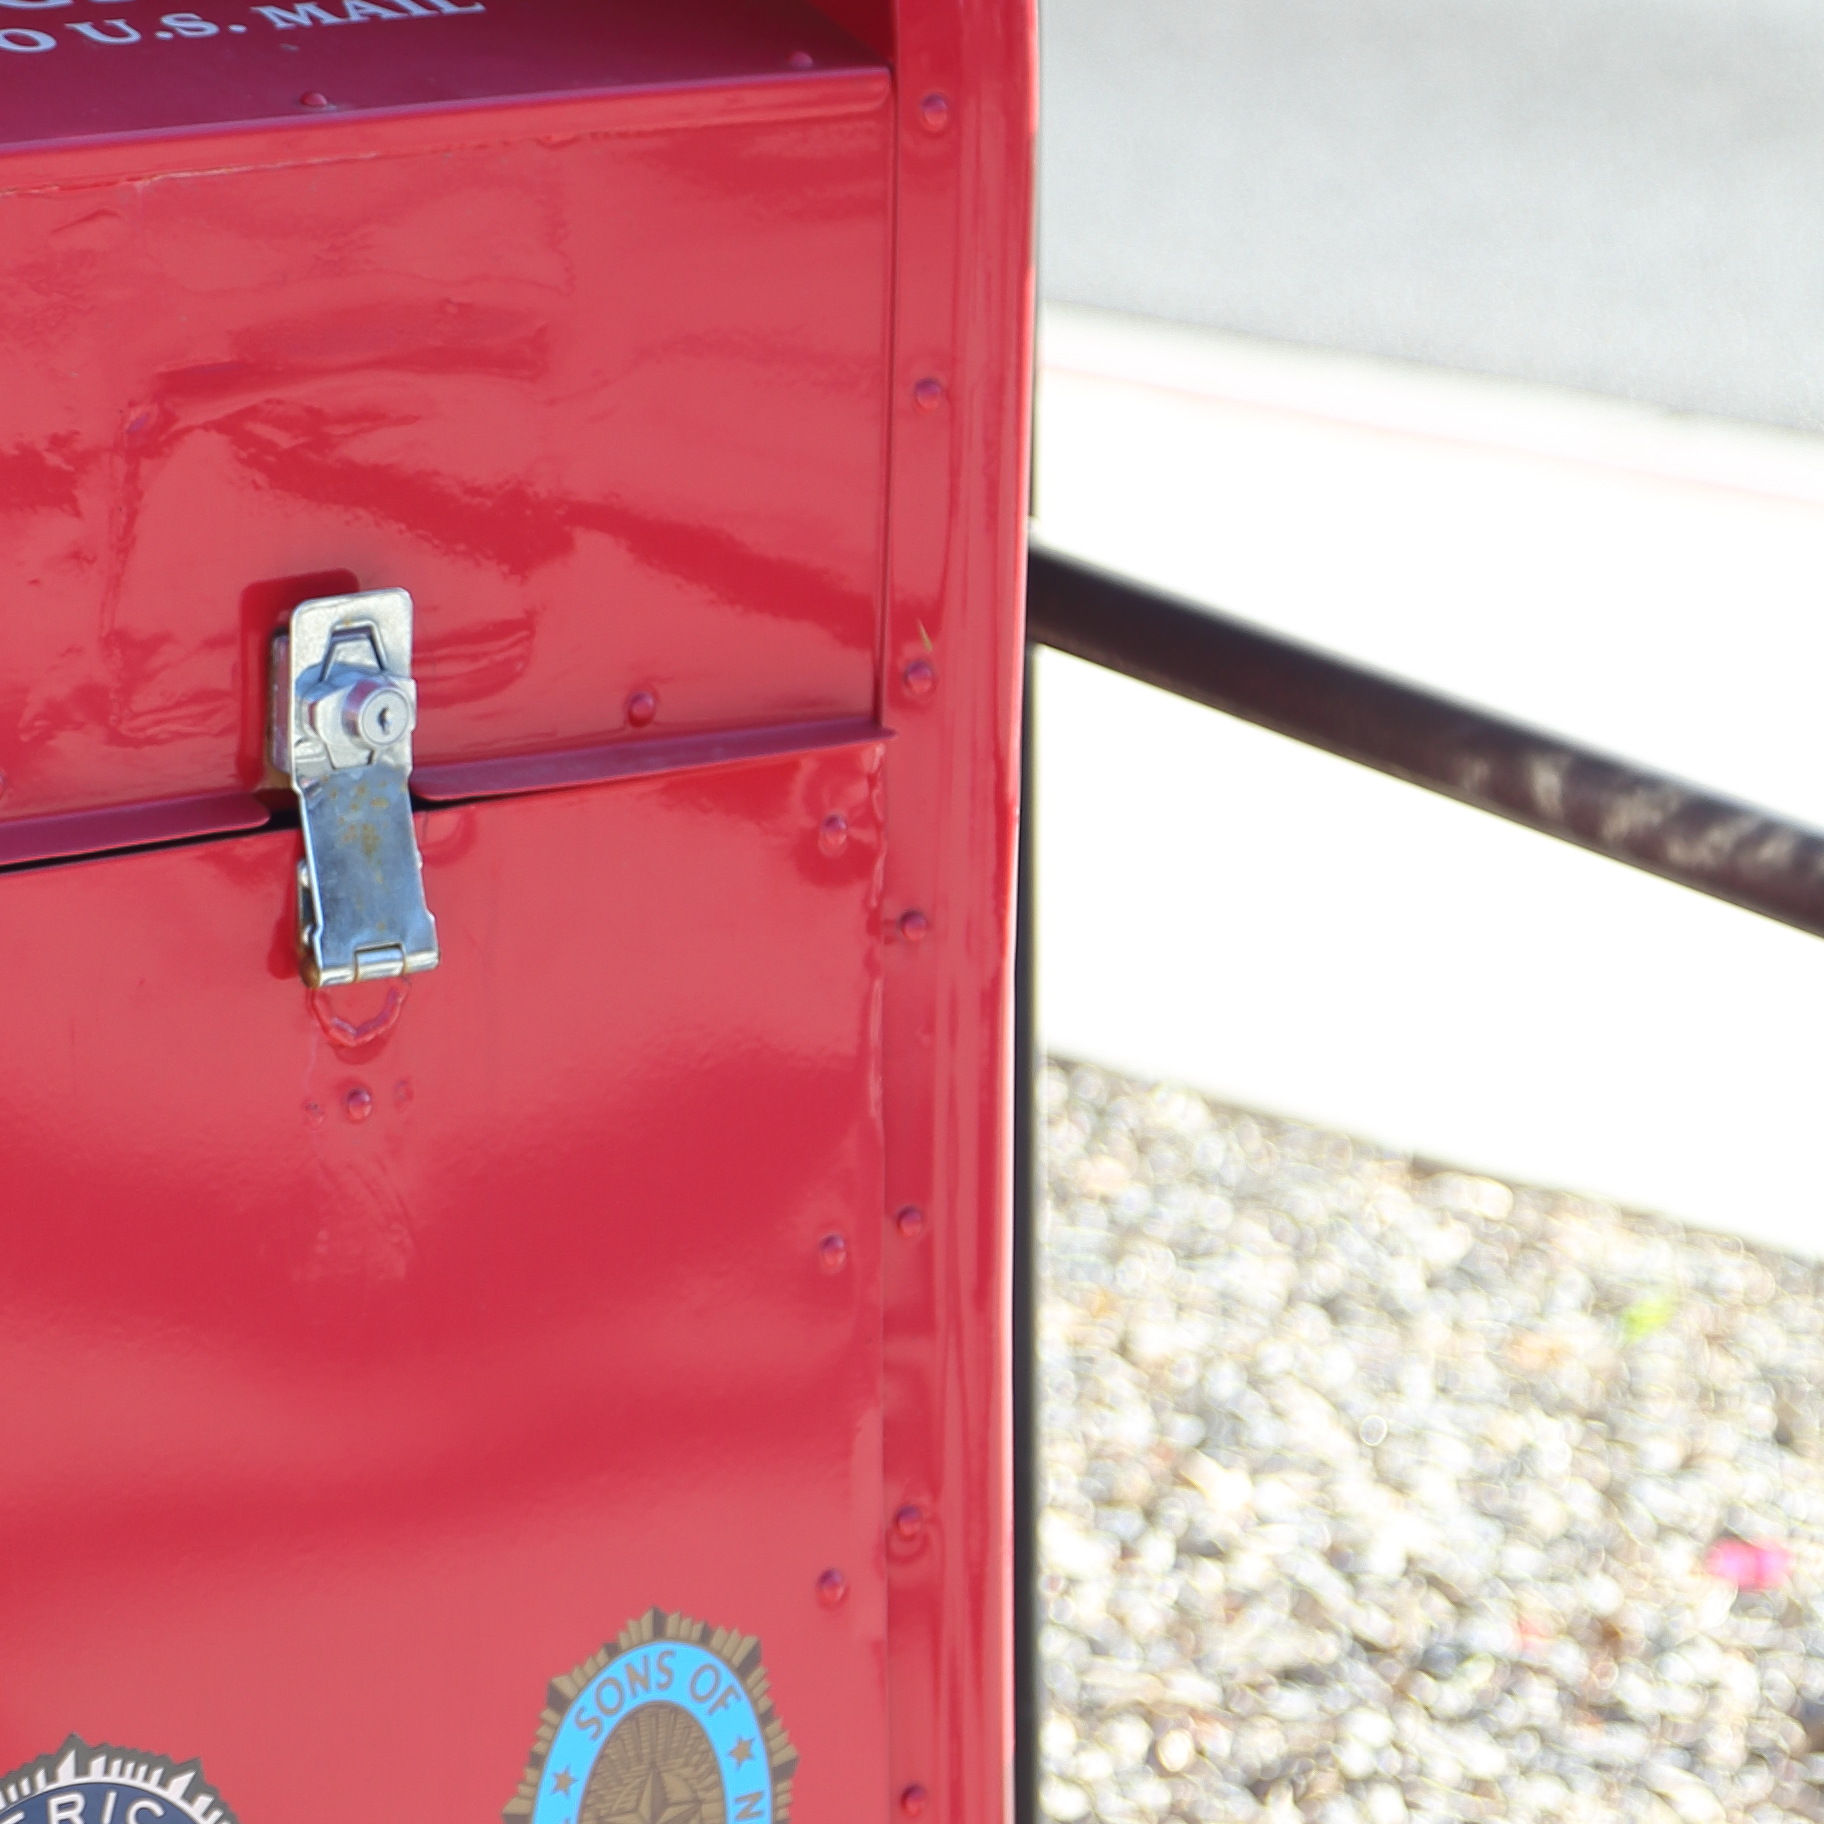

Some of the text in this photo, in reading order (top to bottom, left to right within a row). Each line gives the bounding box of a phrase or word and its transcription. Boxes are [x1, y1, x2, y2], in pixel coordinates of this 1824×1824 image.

[66, 13, 247, 47] U.S.
[575, 1650, 743, 1742] SONS OF
